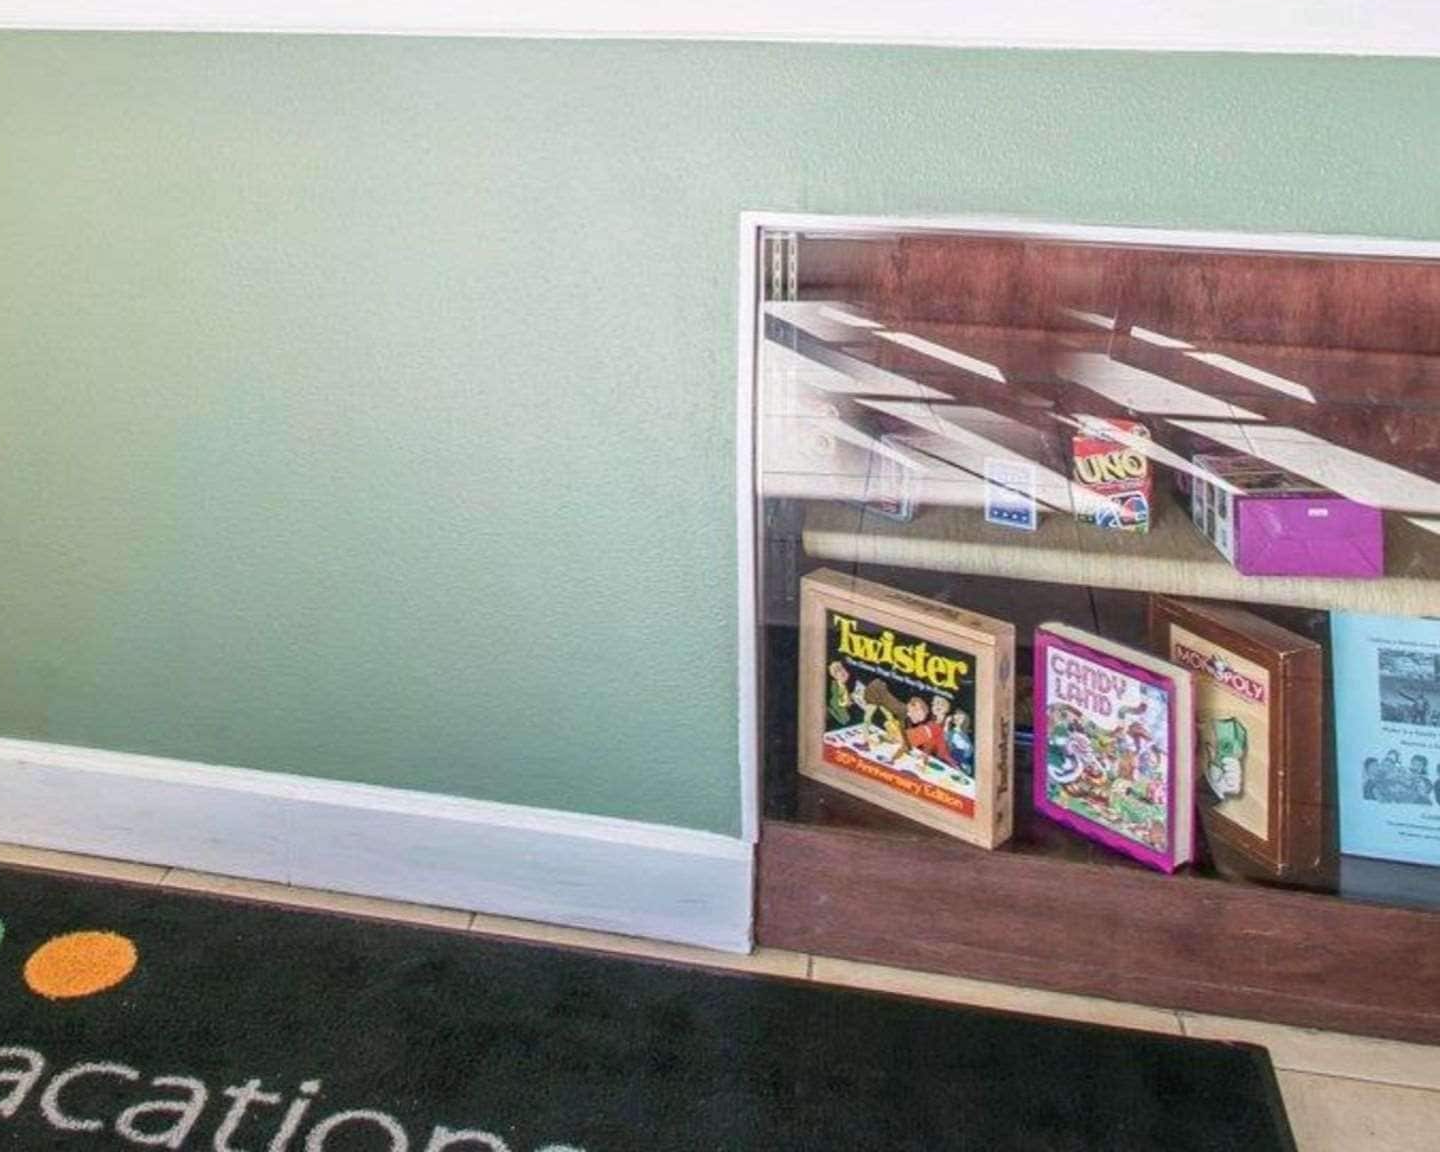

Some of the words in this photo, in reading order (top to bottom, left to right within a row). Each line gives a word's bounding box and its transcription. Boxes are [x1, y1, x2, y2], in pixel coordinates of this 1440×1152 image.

[1073, 449, 1147, 484] UNO
[833, 614, 968, 691] Twister
[1051, 653, 1127, 699] CANDY
[1056, 677, 1112, 716] LAND
